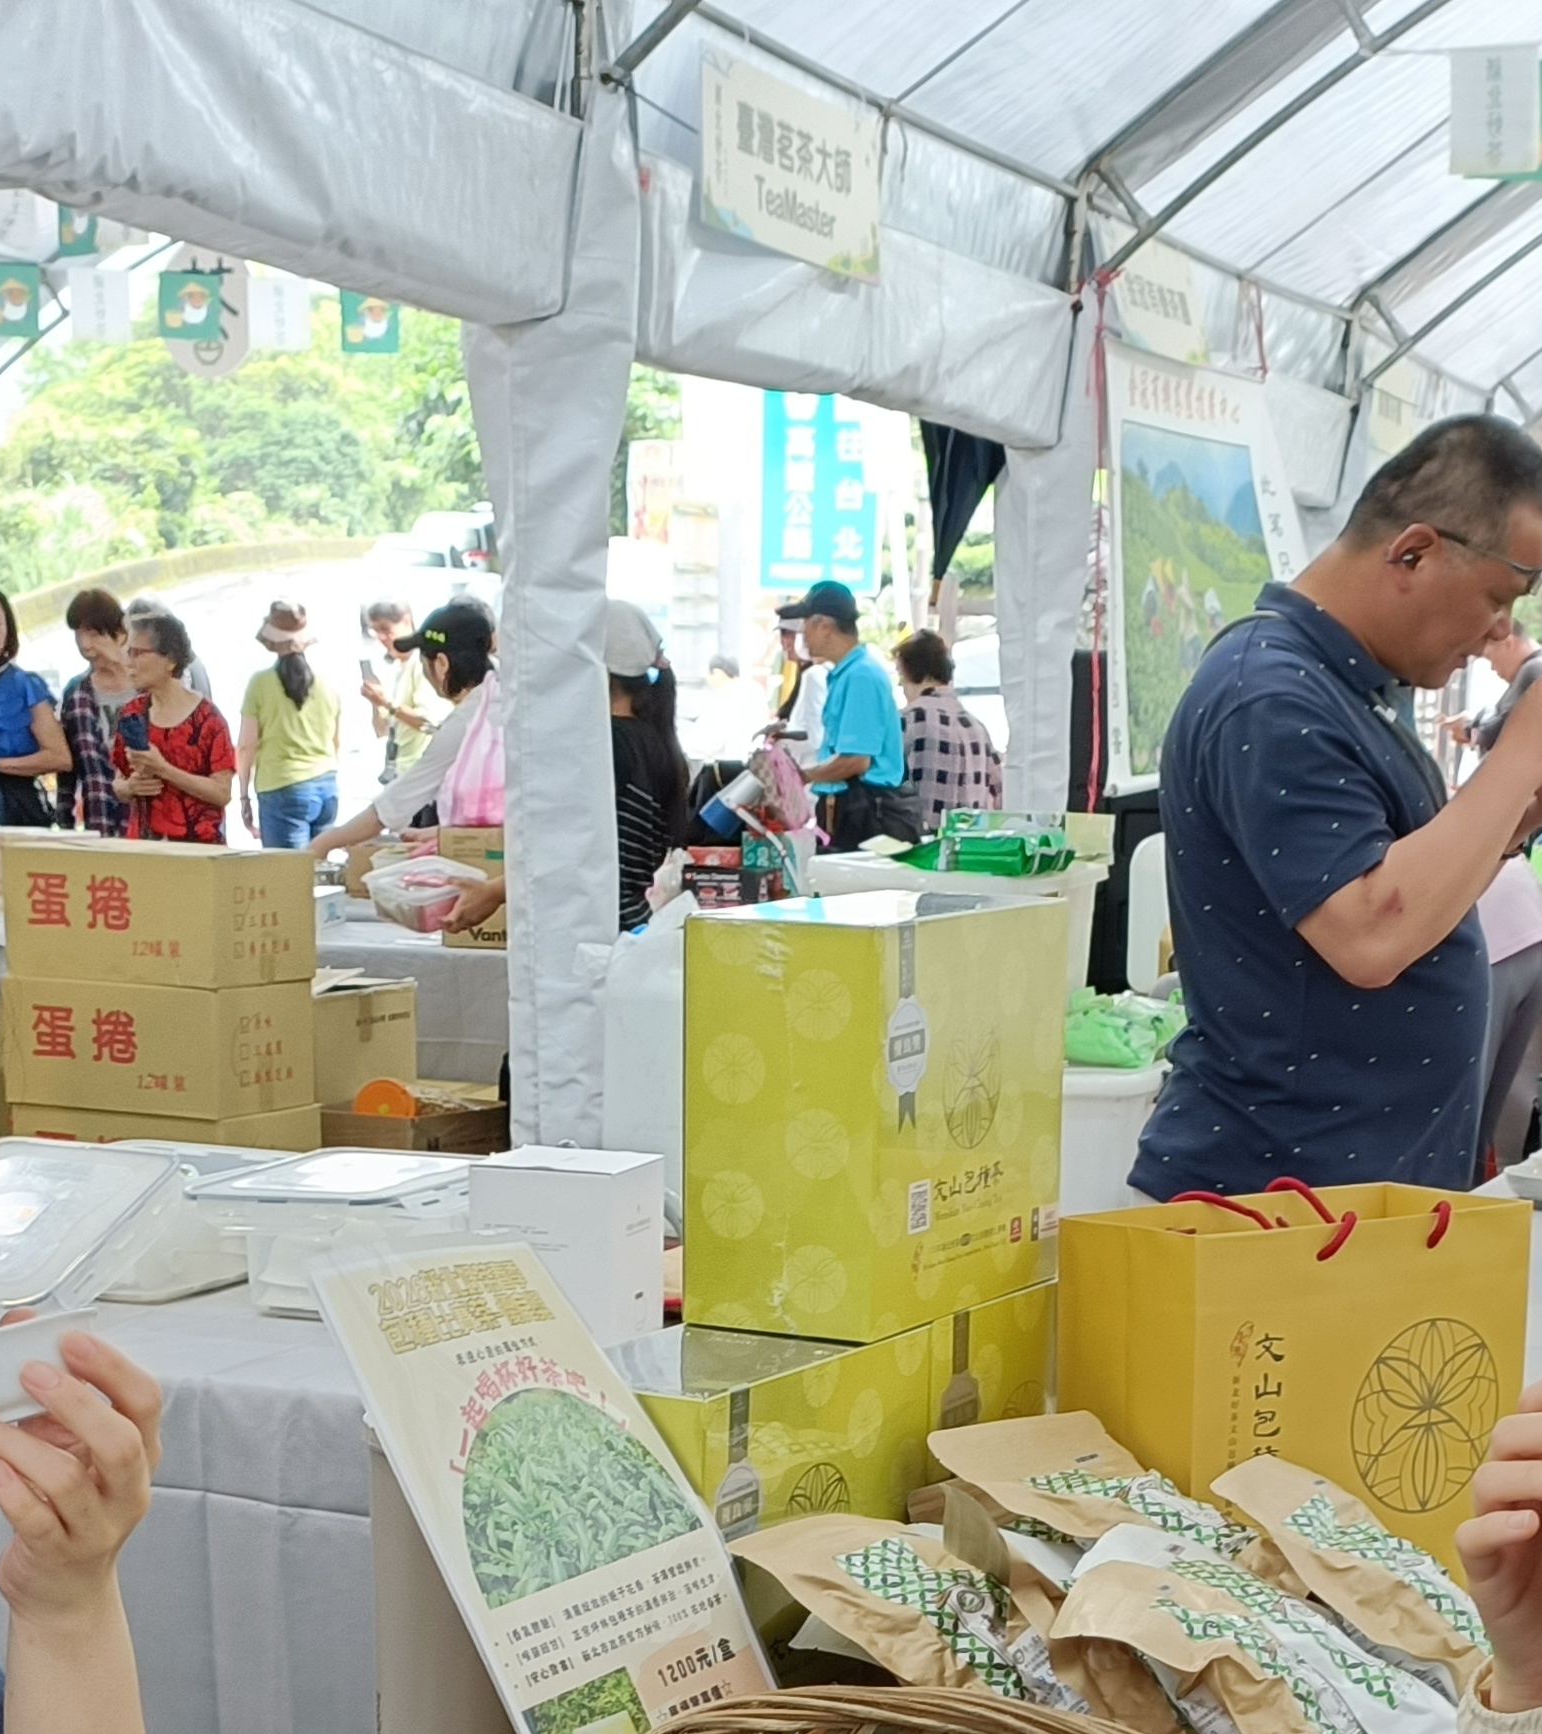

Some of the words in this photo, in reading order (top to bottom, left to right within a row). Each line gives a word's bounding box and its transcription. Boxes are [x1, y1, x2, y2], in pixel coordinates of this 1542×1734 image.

[26, 871, 133, 932] 蛋捲
[32, 1003, 139, 1065] 蛋捲
[658, 1637, 737, 1688] 1200元/盒
